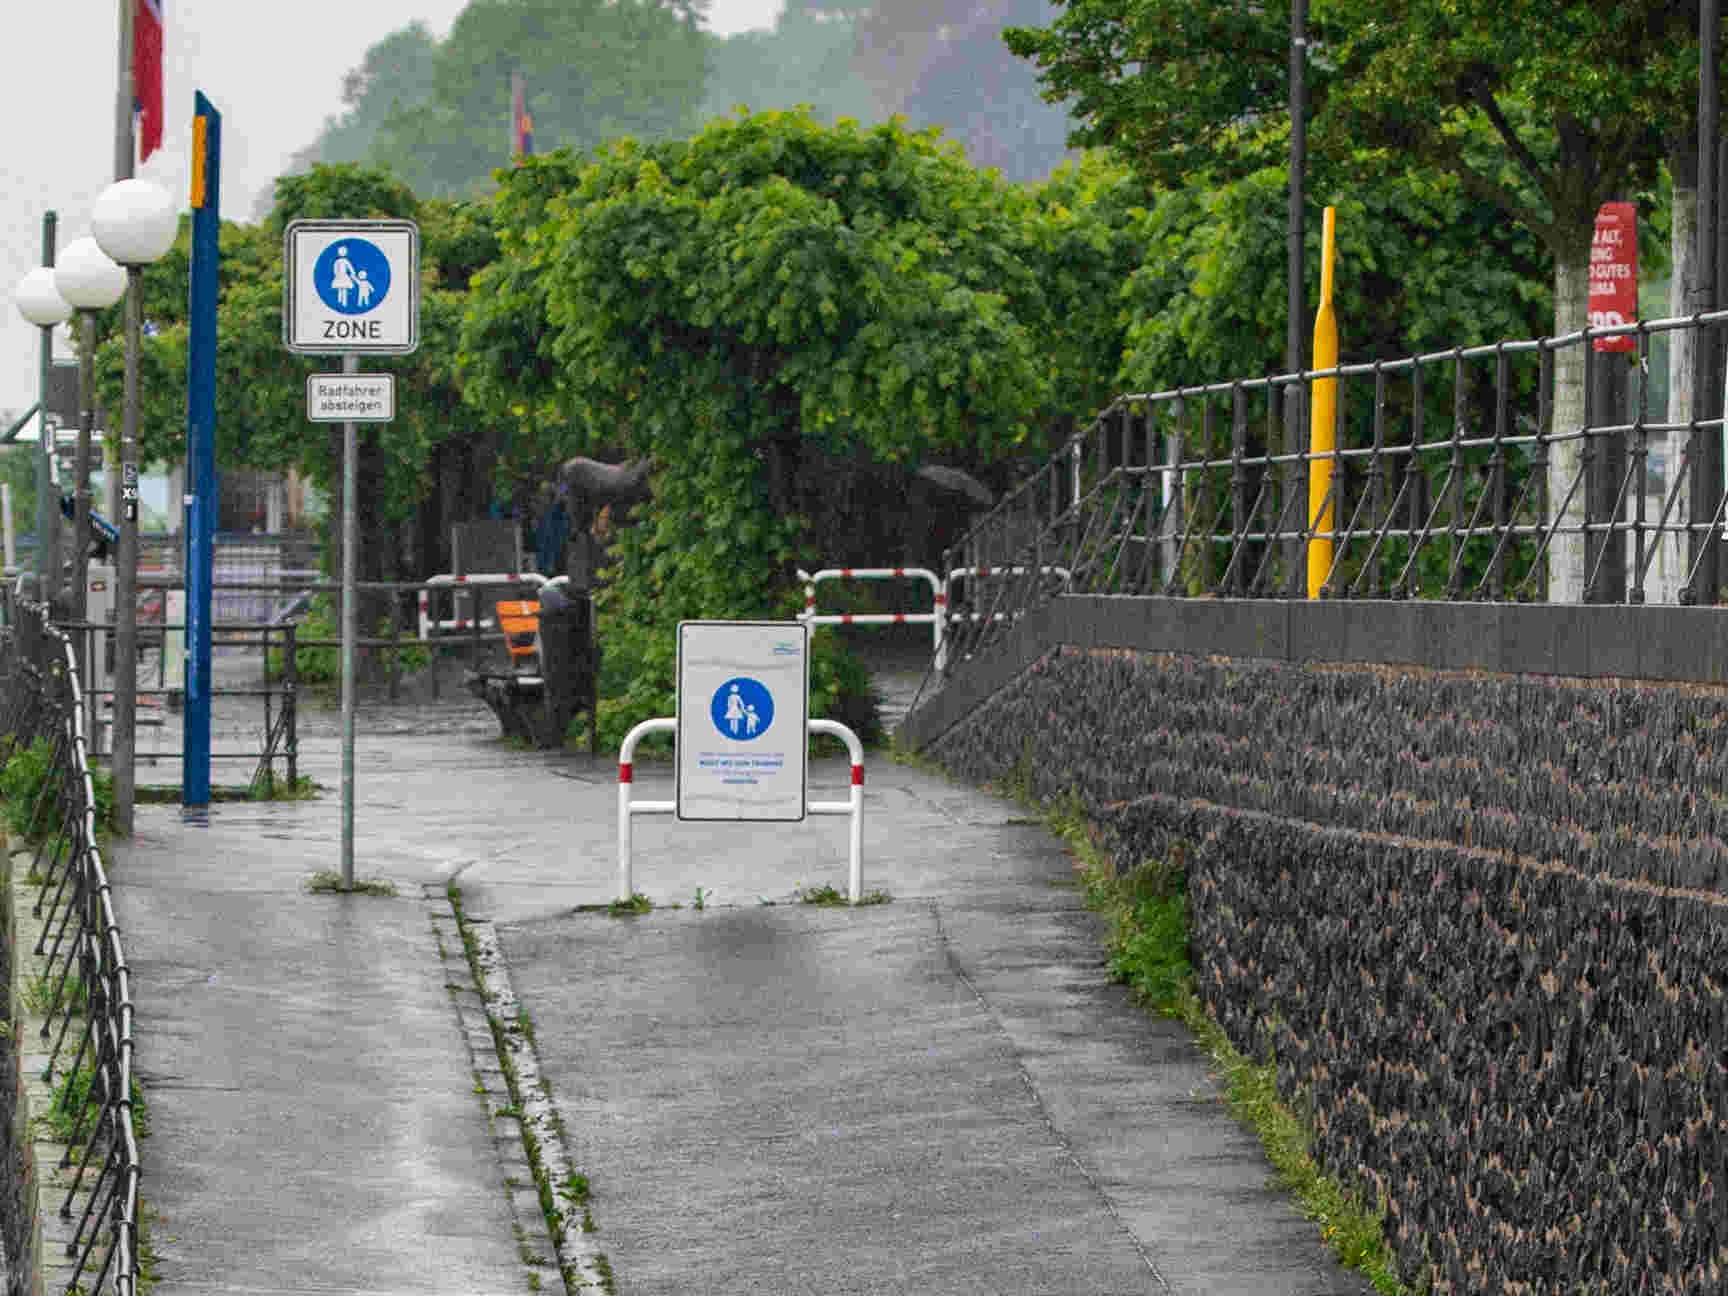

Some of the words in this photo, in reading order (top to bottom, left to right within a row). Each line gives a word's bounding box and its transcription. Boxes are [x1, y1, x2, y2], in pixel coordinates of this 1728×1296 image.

[322, 320, 383, 339] ZONE
[319, 384, 382, 397] Radfahrer
[320, 401, 382, 414] absteigen
